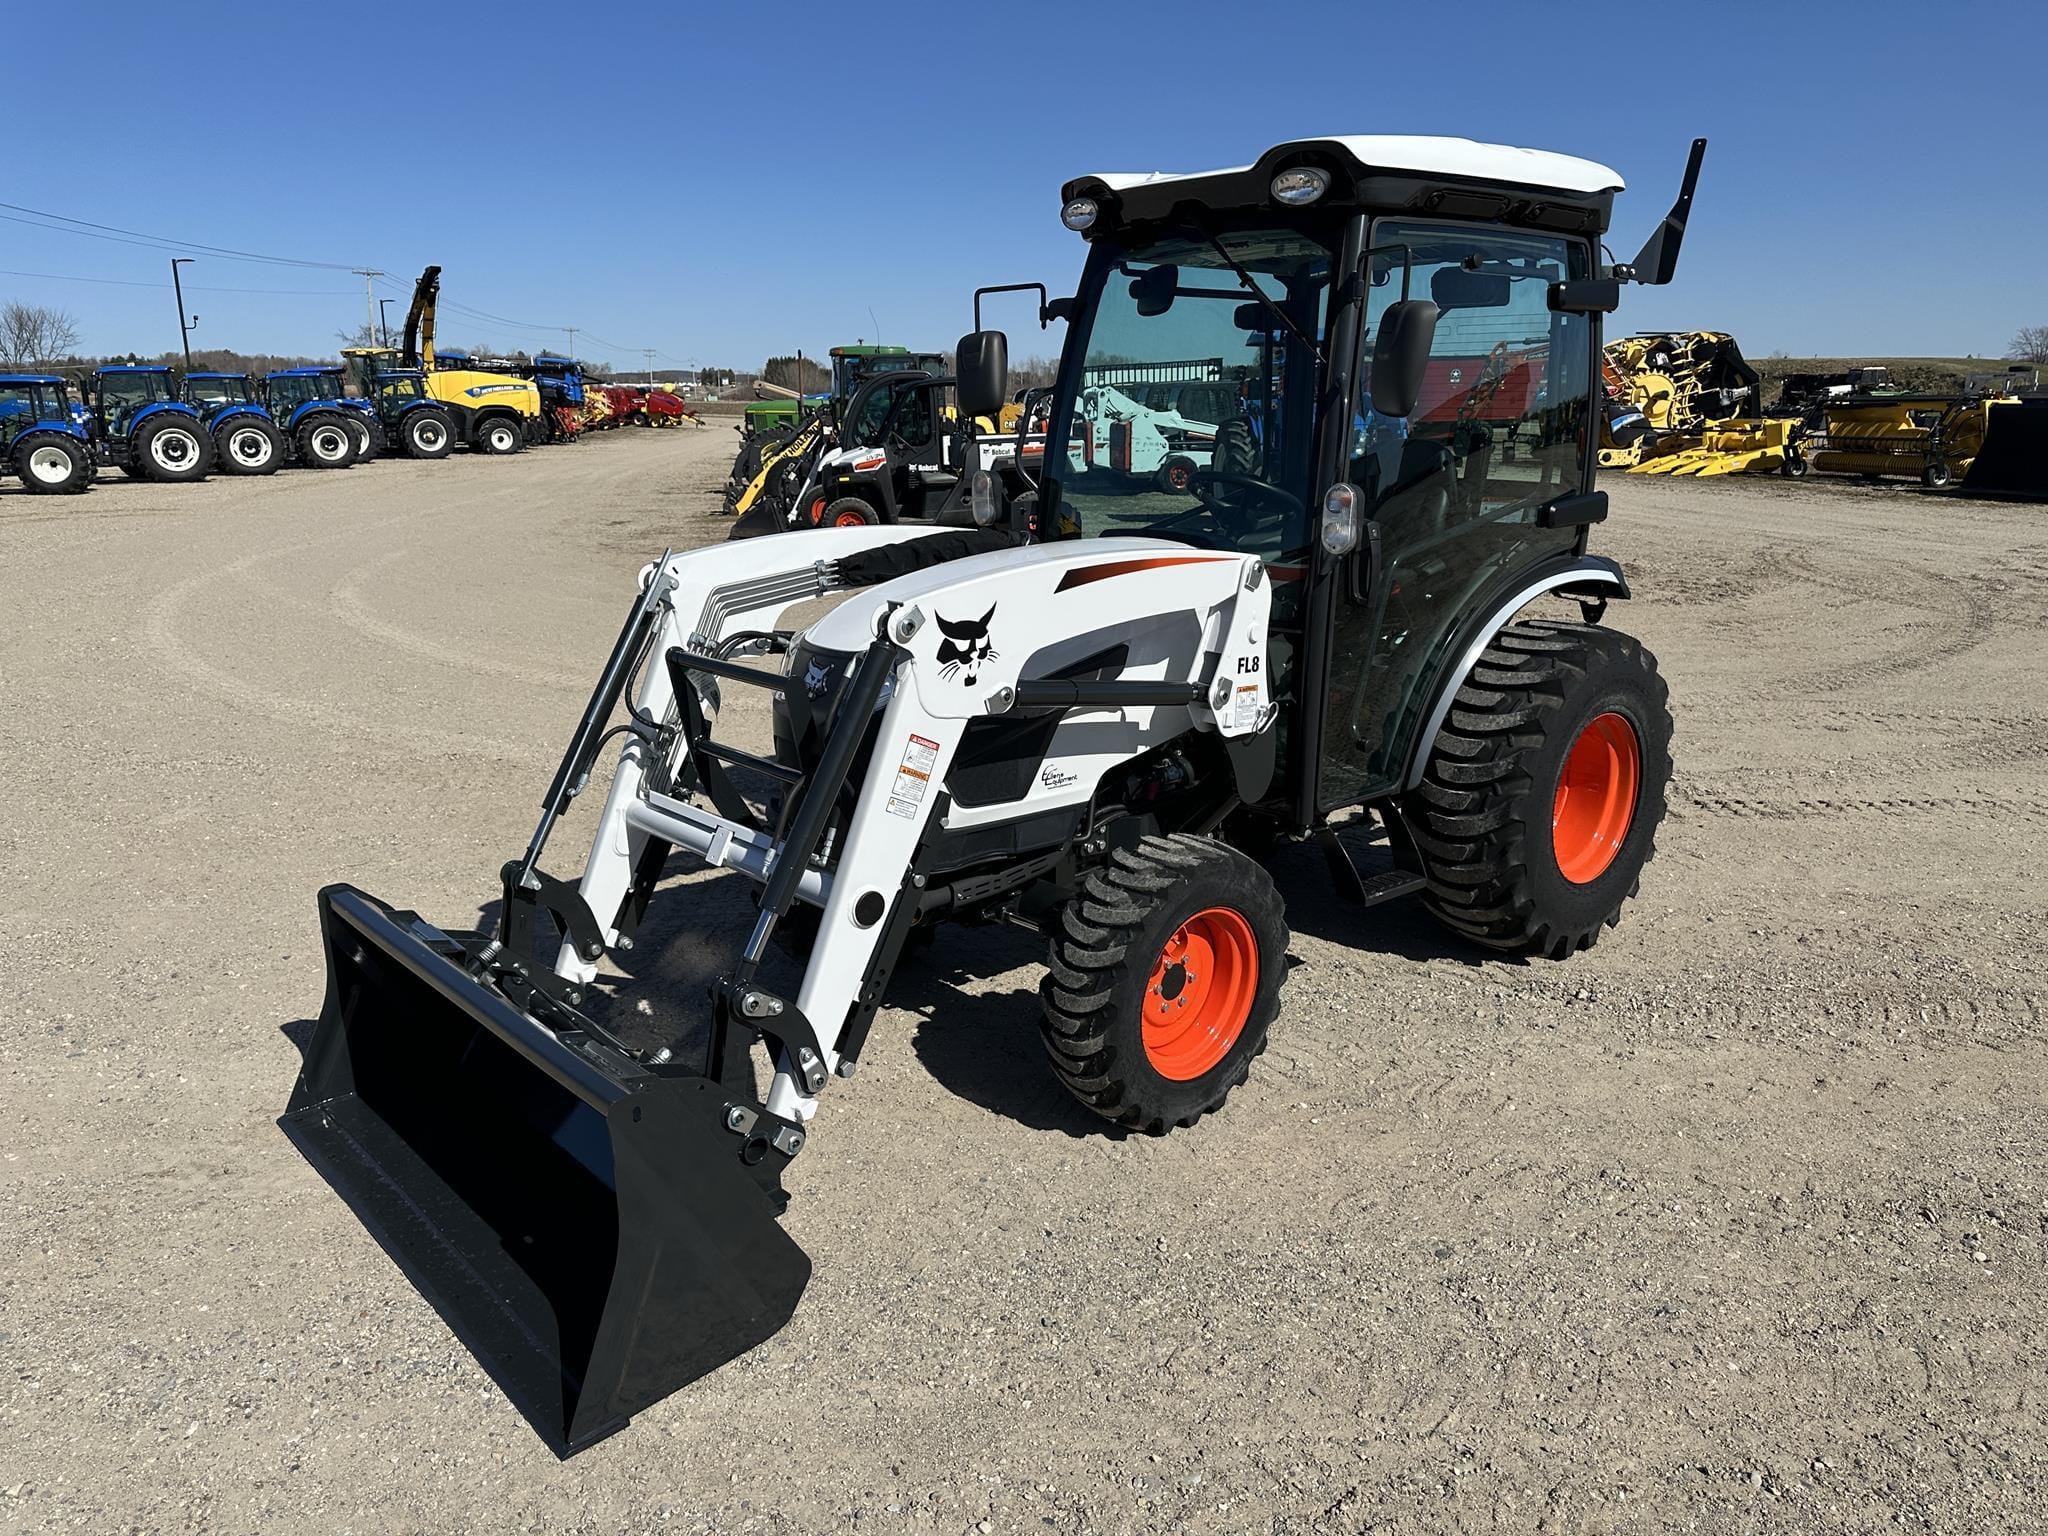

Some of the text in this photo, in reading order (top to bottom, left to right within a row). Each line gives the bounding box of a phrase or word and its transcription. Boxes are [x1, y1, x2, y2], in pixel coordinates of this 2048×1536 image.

[1004, 420, 1016, 429] CAT
[918, 464, 938, 472] Bobcat
[1237, 656, 1260, 674] FL8
